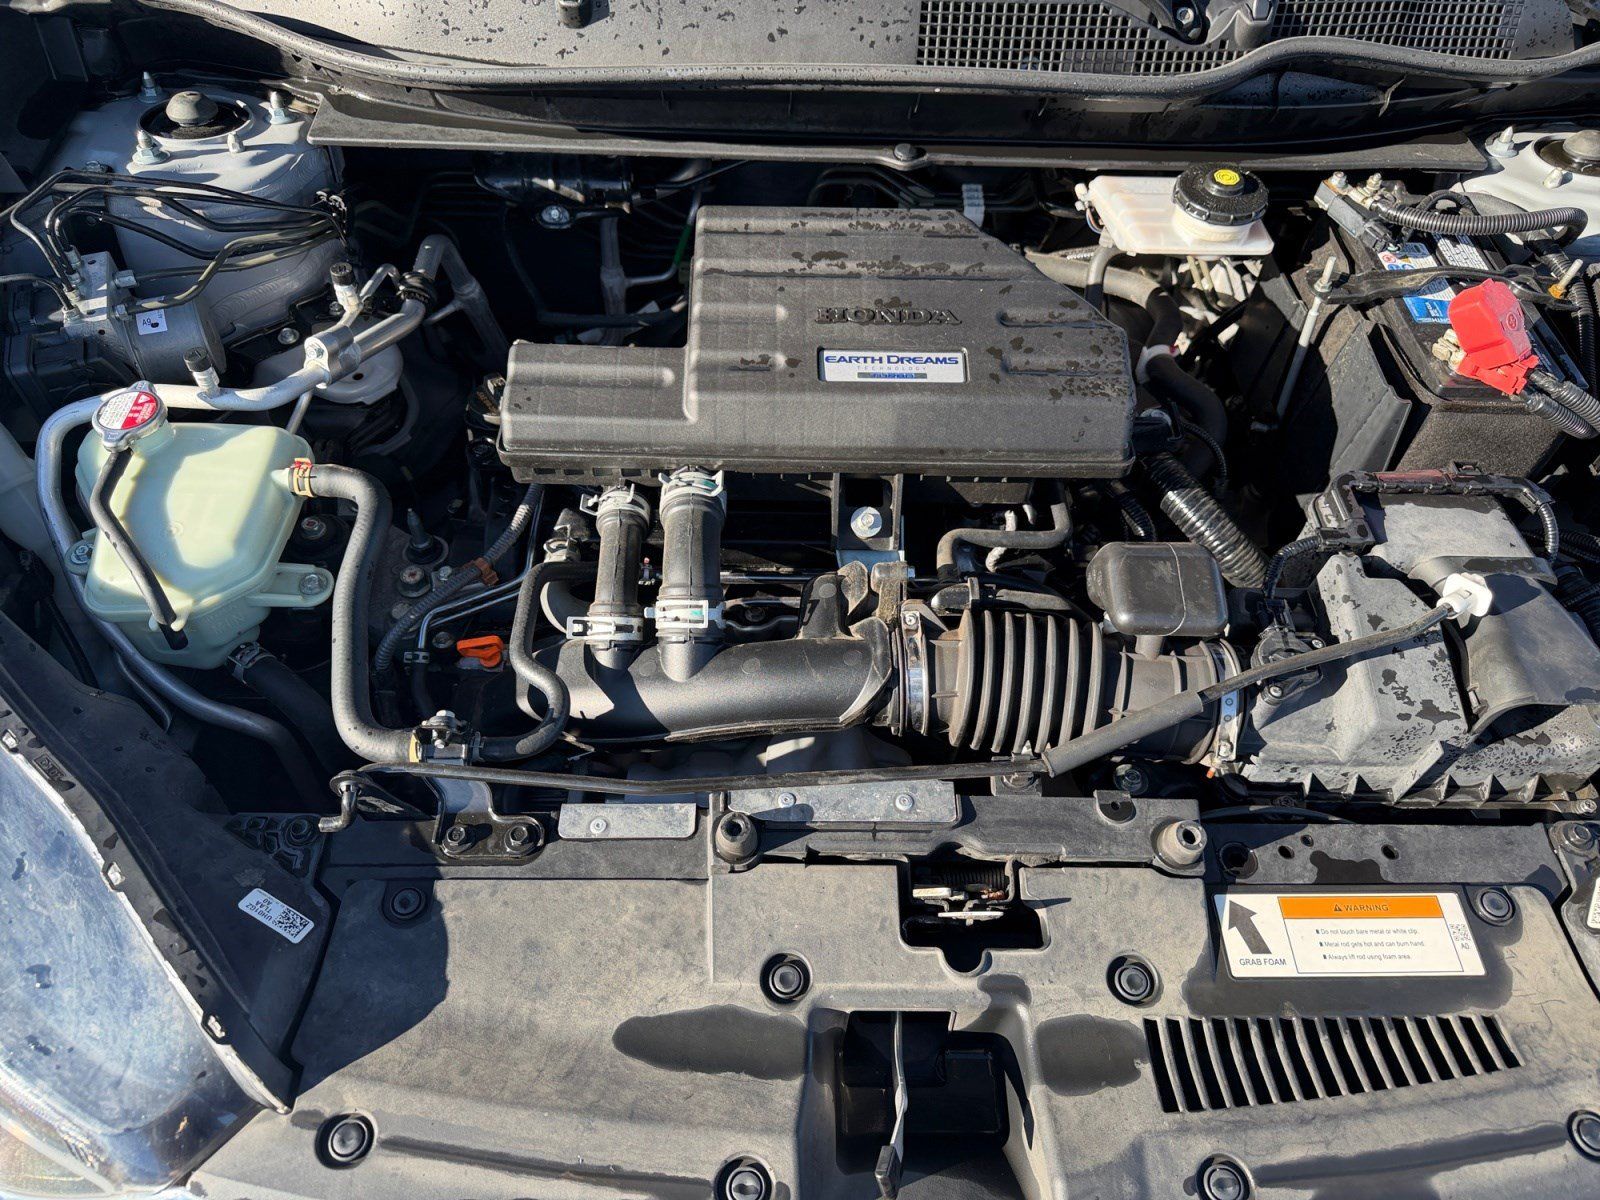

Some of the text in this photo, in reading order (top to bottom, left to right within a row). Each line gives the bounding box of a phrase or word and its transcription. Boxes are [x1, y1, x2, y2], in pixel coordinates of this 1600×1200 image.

[815, 307, 963, 325] HONDA
[825, 355, 959, 365] EARTH DREAMS
[255, 900, 272, 913] TLAA
[1343, 904, 1389, 912] WARNING
[1239, 958, 1287, 966] GRAB FOAM
